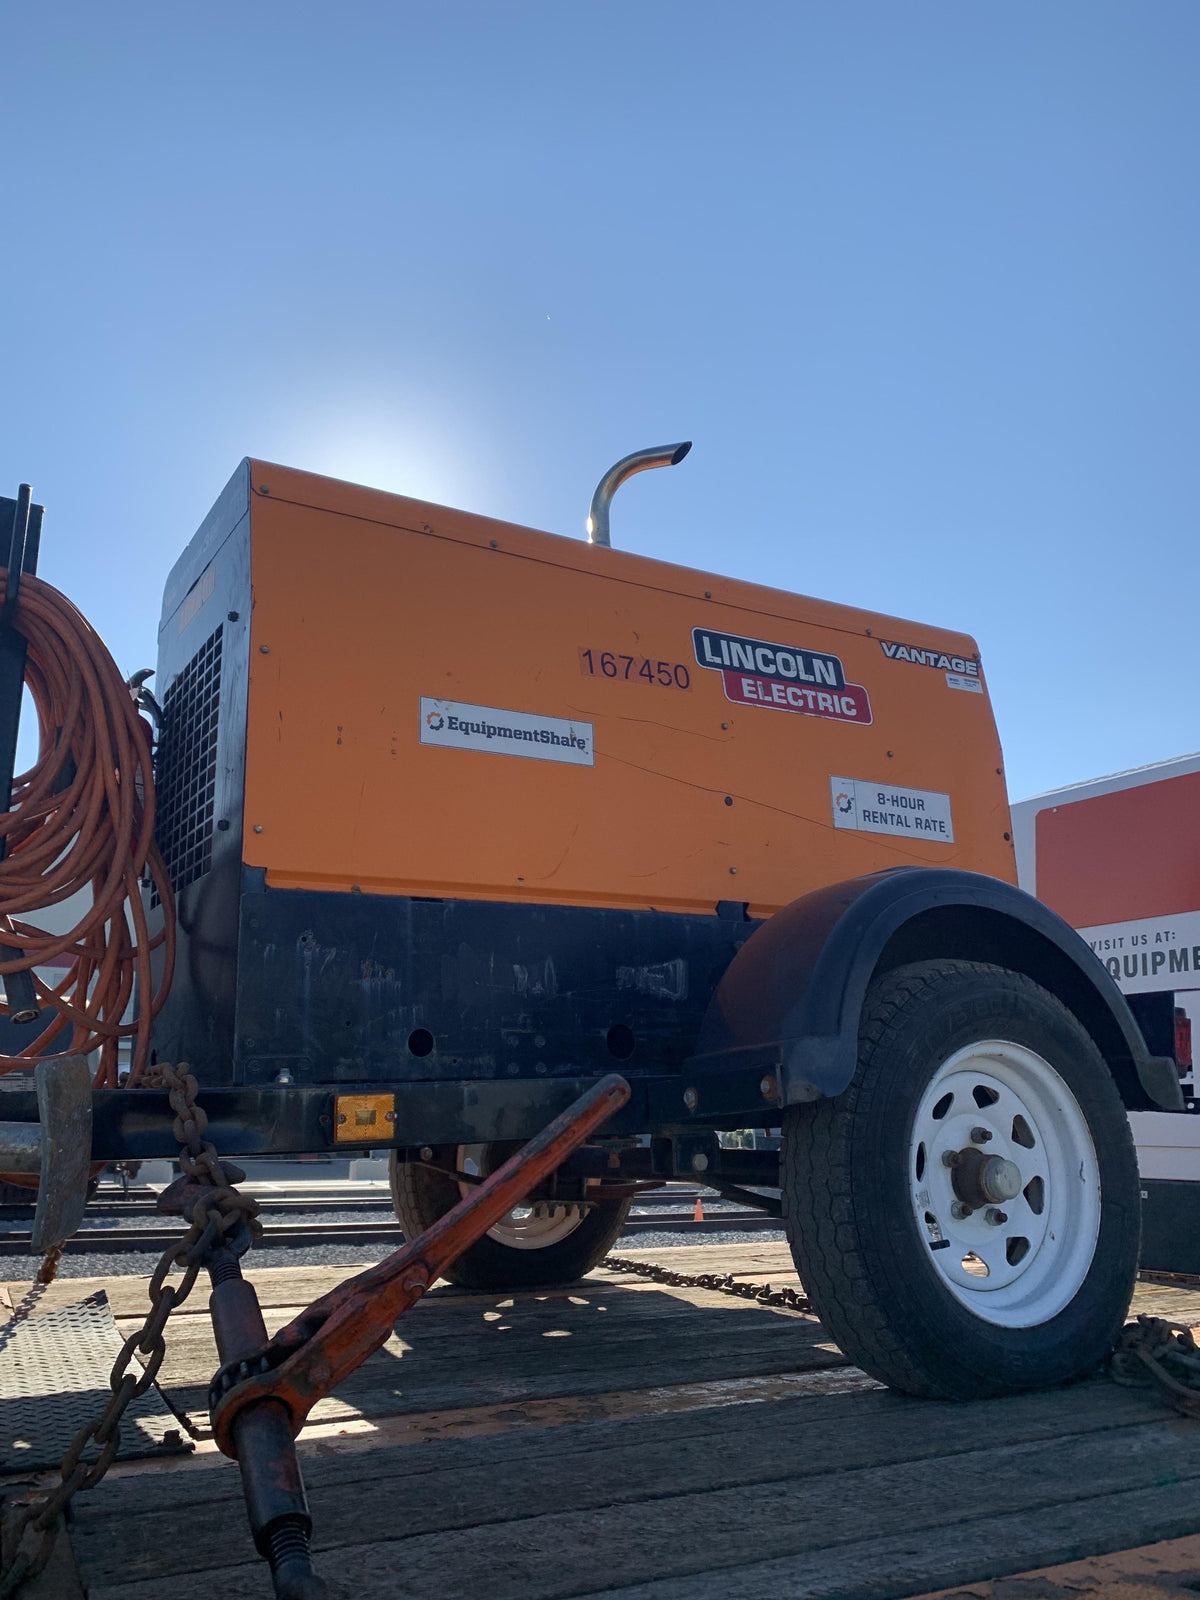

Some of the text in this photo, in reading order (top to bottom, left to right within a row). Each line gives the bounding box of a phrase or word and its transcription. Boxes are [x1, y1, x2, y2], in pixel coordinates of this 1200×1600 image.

[582, 649, 690, 689] 167450
[702, 635, 837, 686] LINCOLN
[879, 640, 979, 677] VANTAGE
[741, 677, 857, 716] ELECTRIC
[447, 715, 587, 750] EquipmentShare
[877, 793, 925, 811] 8-HOUR
[863, 809, 946, 833] RENTAL RATE
[1090, 930, 1176, 951] VISIT US AT:
[1100, 945, 1200, 981] QUIPME
